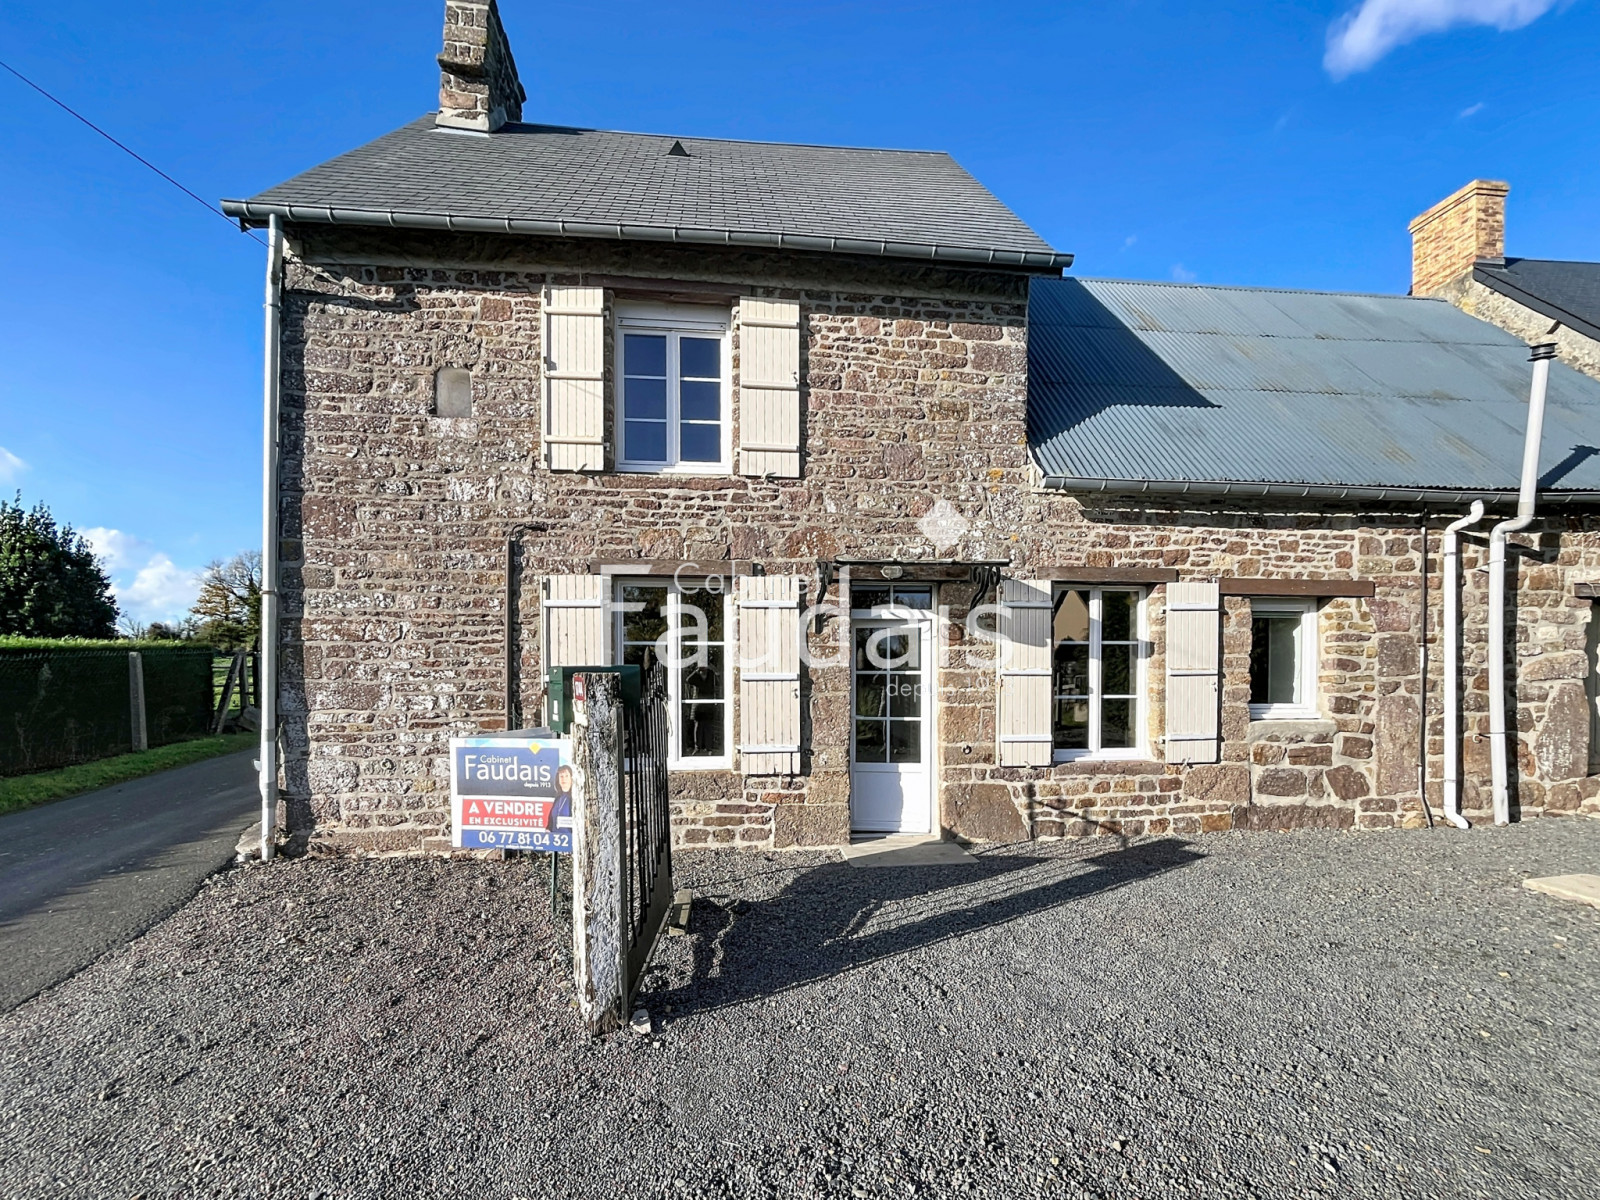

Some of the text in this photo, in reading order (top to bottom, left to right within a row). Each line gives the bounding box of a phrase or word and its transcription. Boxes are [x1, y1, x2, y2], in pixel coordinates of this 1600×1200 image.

[480, 755, 512, 763] Cabinet
[464, 755, 551, 781] Faudais
[468, 801, 544, 816] A VENDRE
[469, 816, 544, 827] EN EXCLUSIVITÉ
[479, 831, 496, 844] 06
[498, 832, 515, 844] 77
[533, 834, 550, 846] 04
[553, 834, 569, 847] 32
